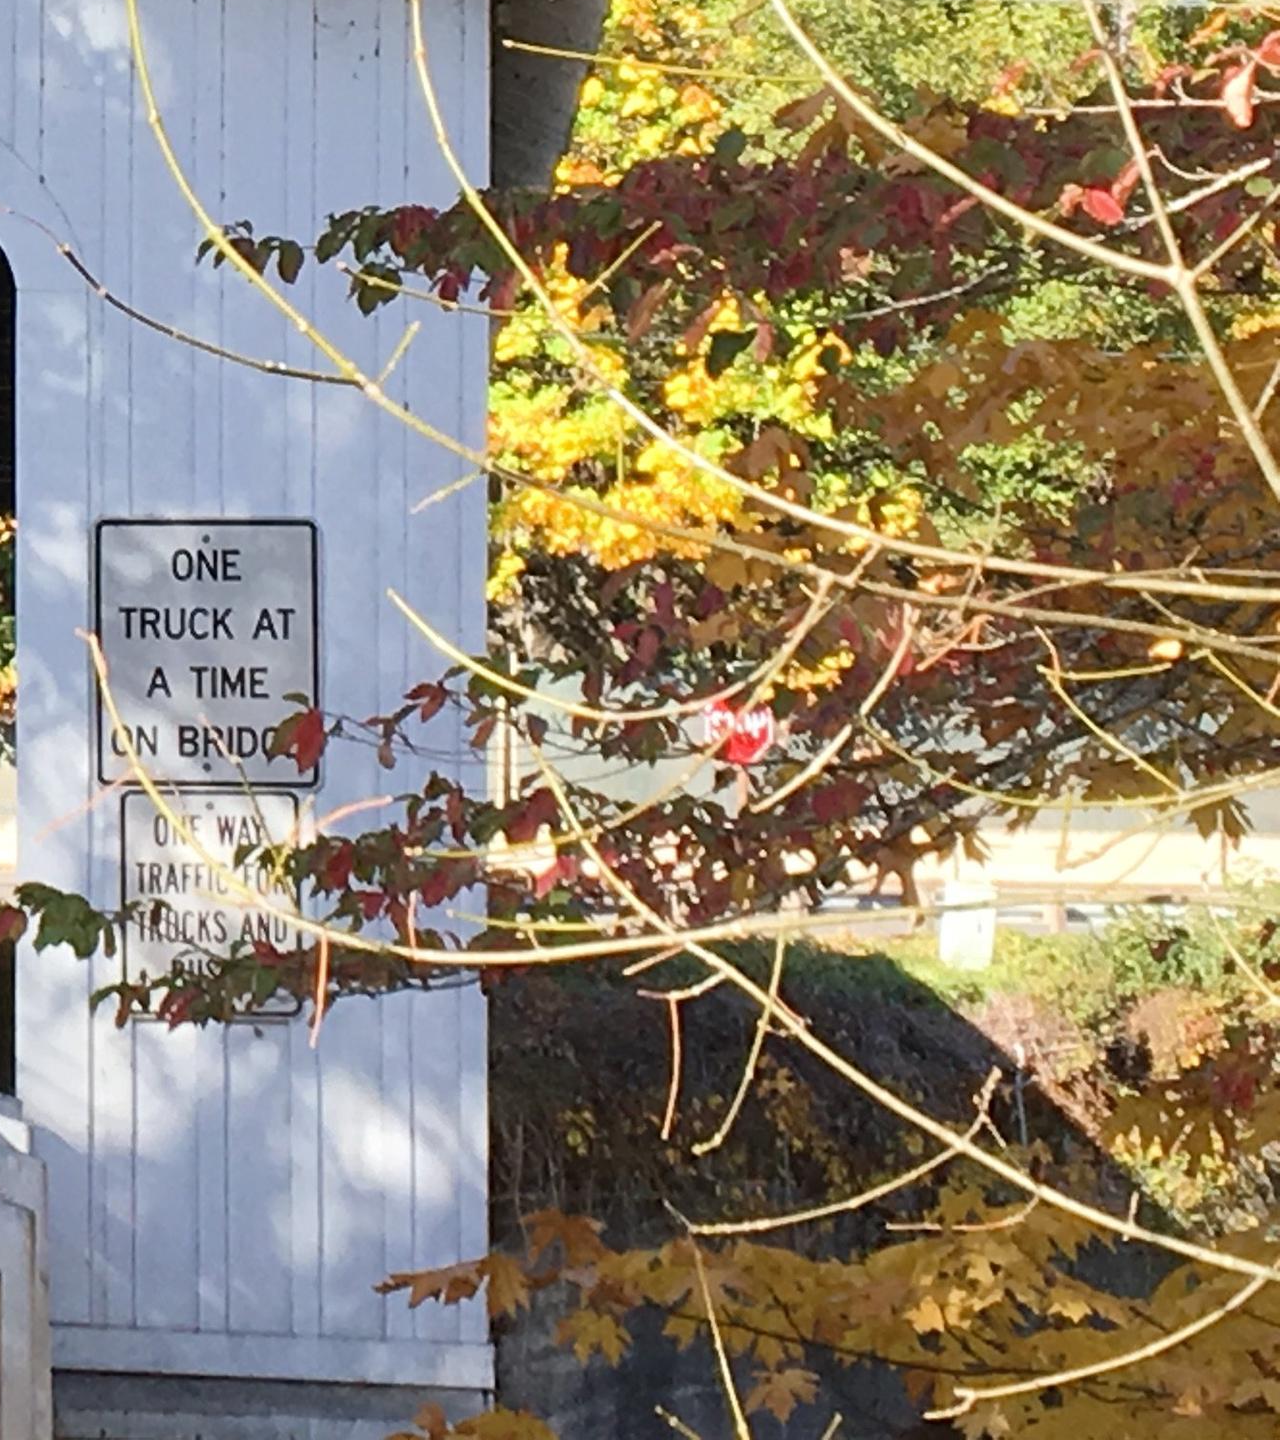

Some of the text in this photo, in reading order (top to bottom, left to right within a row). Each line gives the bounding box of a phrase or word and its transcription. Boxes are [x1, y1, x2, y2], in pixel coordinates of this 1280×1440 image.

[172, 549, 242, 582] ONE
[119, 607, 296, 640] TRUCK AT
[146, 666, 270, 700] A TIME
[111, 725, 158, 758] ON
[153, 814, 265, 847] ONE WAY
[136, 862, 230, 895] TRAFFIC
[137, 910, 228, 945] TRUCKS
